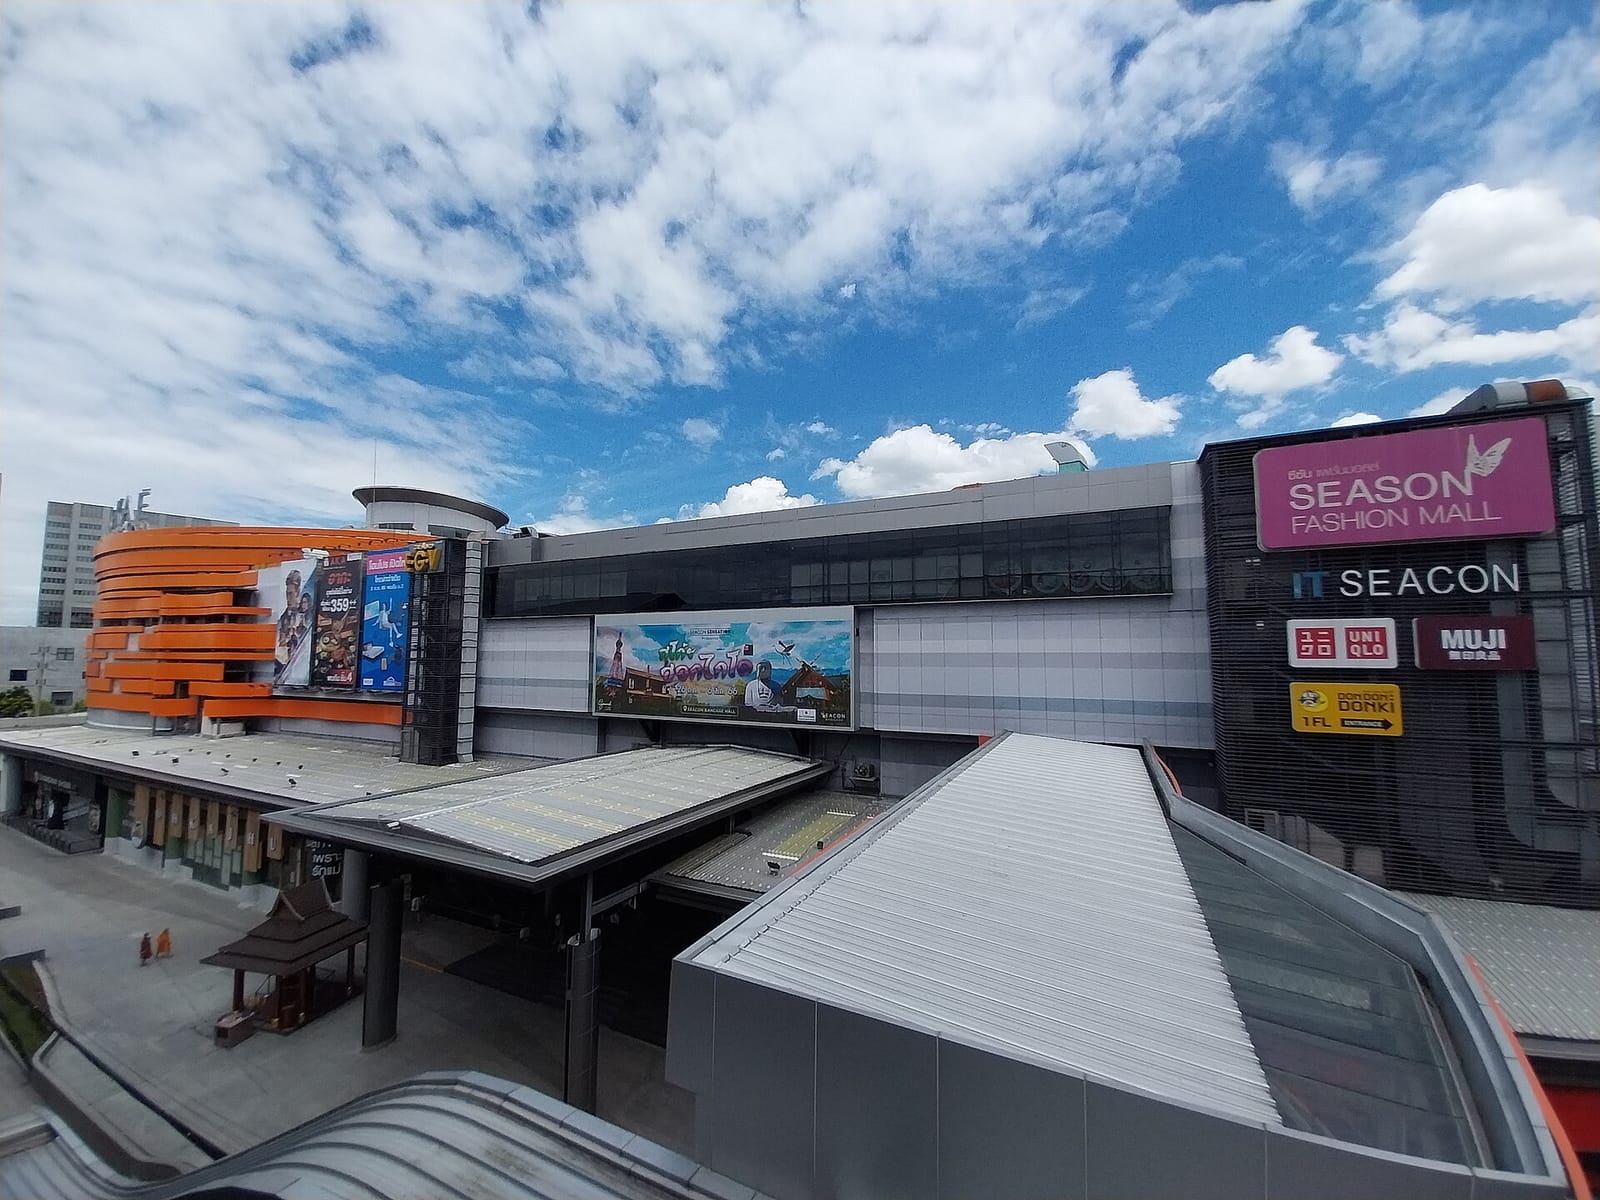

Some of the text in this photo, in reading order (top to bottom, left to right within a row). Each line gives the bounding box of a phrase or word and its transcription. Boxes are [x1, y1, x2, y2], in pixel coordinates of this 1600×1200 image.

[1289, 470, 1472, 511] SEASON
[1291, 500, 1502, 535] FASHION MALL
[405, 548, 440, 572] EGV
[1292, 563, 1520, 599] IT SEACON
[1349, 630, 1381, 642] UNI
[1441, 629, 1507, 650] MUJI
[1351, 644, 1385, 657] QLO
[1338, 701, 1396, 713] DONKI
